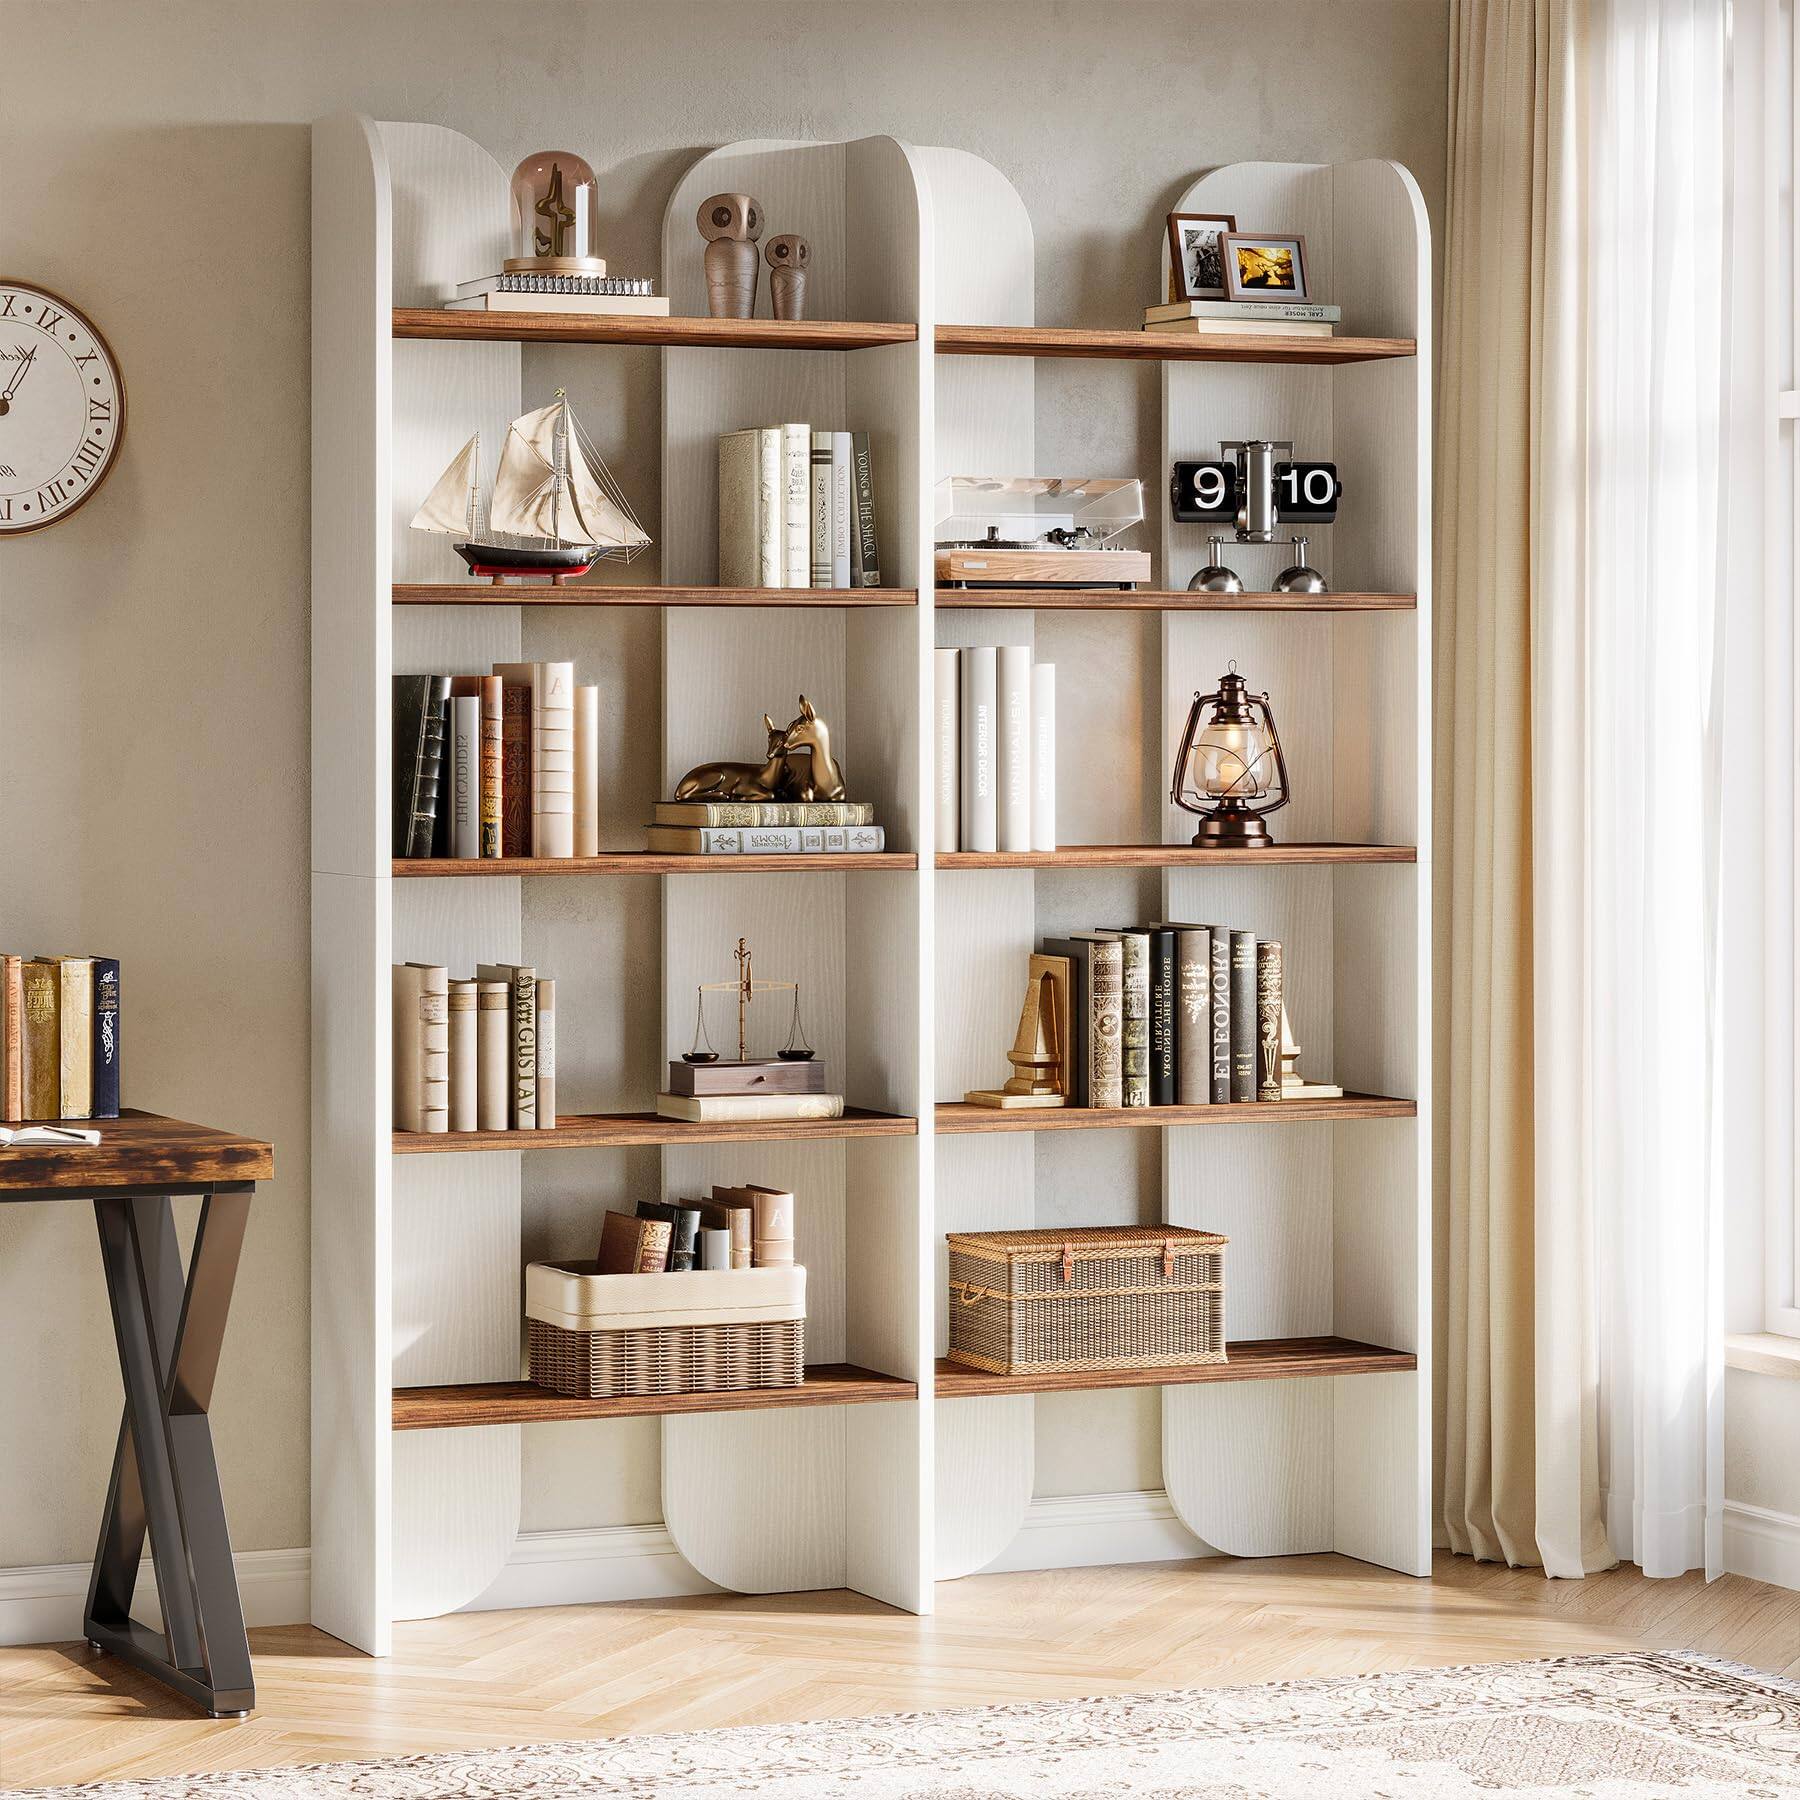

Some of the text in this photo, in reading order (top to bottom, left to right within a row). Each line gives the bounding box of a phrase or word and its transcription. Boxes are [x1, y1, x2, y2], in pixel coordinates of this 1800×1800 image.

[857, 450, 870, 490] YOUNG
[1193, 466, 1226, 510] 9
[1281, 469, 1334, 505] 10
[836, 465, 847, 560] JUMBO COLLECTION
[860, 499, 877, 559] THE SHACK
[550, 677, 565, 696] A
[977, 704, 988, 797] INTERIOR DECOR
[1009, 690, 1023, 806] MINIMALISM
[517, 1027, 536, 1115] GUSTAV
[768, 1208, 785, 1227] A
